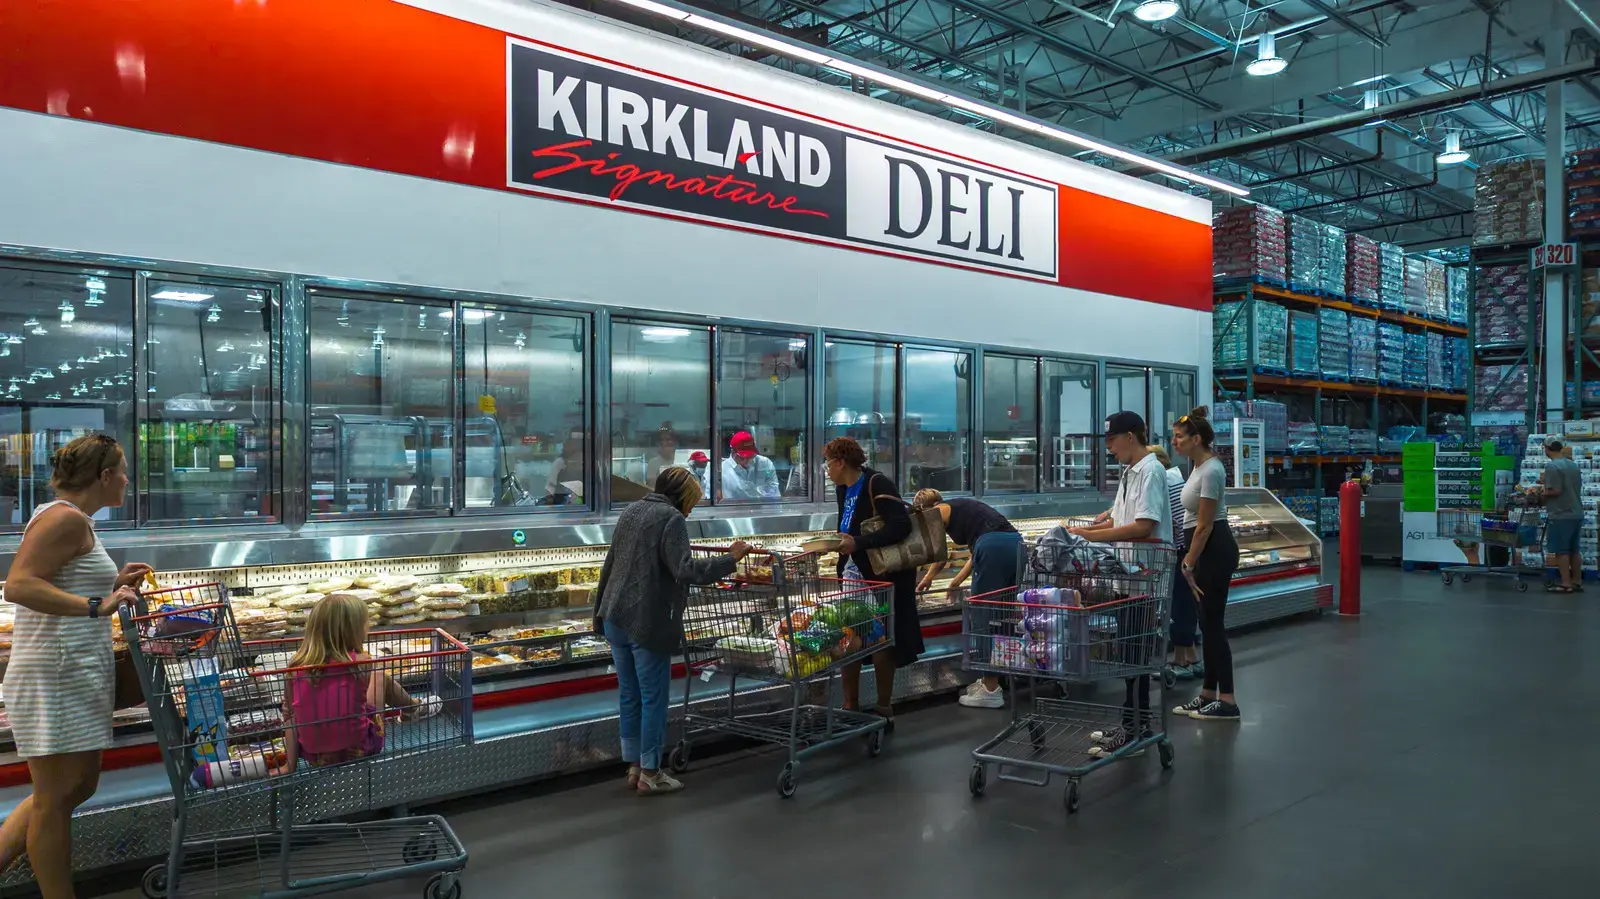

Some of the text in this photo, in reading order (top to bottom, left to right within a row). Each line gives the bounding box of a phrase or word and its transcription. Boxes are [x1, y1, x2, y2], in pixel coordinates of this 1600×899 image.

[537, 68, 831, 188] KIRKLAND
[532, 139, 830, 219] Signature
[883, 153, 1025, 261] DELI
[1548, 244, 1572, 263] 320
[1406, 531, 1425, 540] AG1
